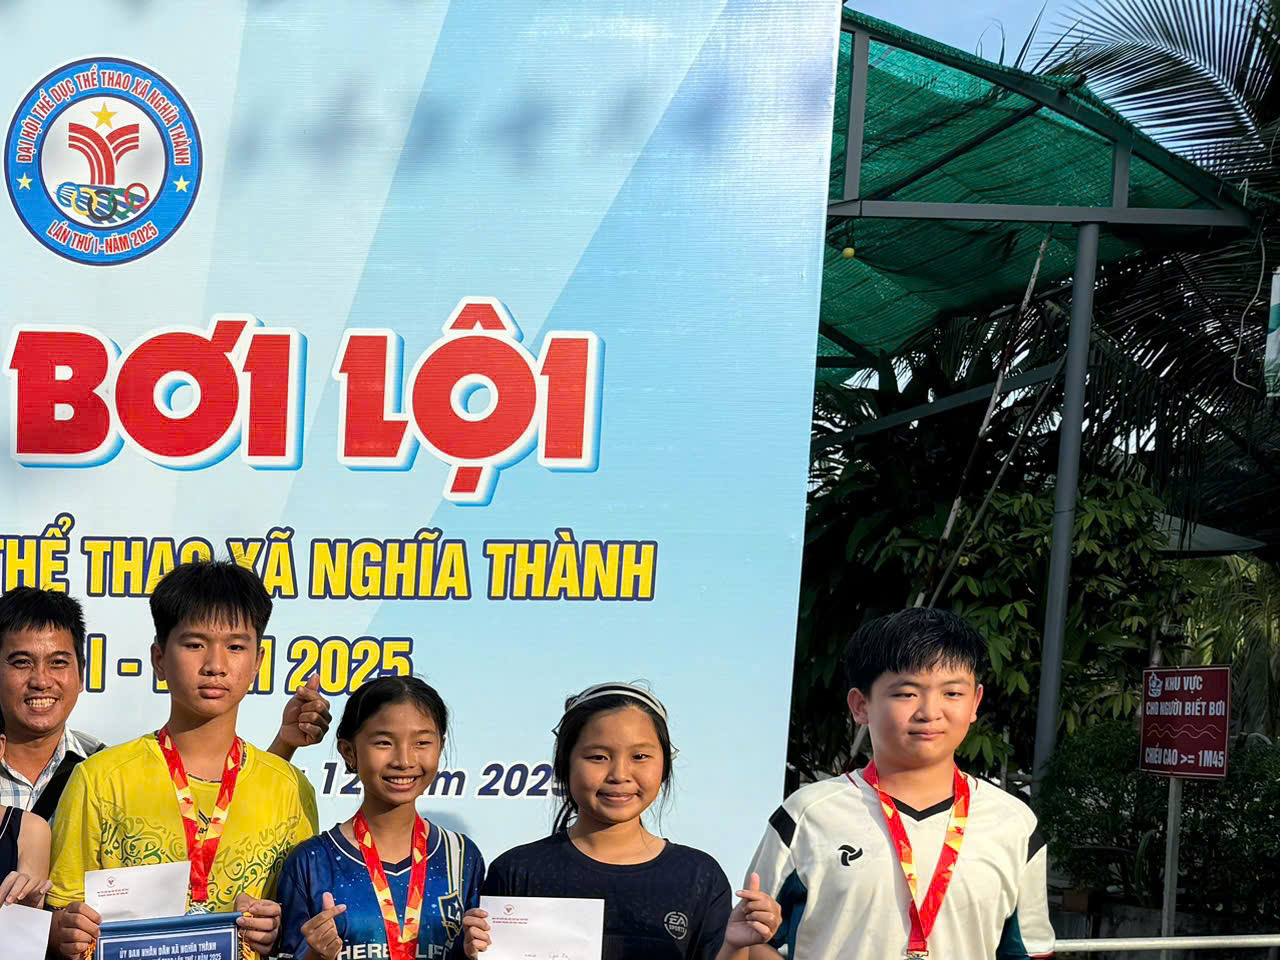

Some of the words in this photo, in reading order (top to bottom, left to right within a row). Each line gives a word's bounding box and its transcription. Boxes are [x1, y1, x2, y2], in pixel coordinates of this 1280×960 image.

[50, 79, 76, 100] DỤC
[100, 70, 131, 91] THAO
[131, 79, 152, 98] XÃ
[130, 221, 159, 247] 2025
[6, 317, 297, 462] BƠI
[338, 299, 596, 498] LỘI
[308, 527, 472, 600] NGHĨA
[483, 528, 658, 601] THÀNH
[1165, 677, 1181, 691] KHU
[1184, 675, 1203, 693] VỰC
[1146, 702, 1159, 715] CHO
[1185, 697, 1206, 716] BIẾT
[1163, 749, 1178, 765] CAO
[1198, 750, 1224, 768] 1M45
